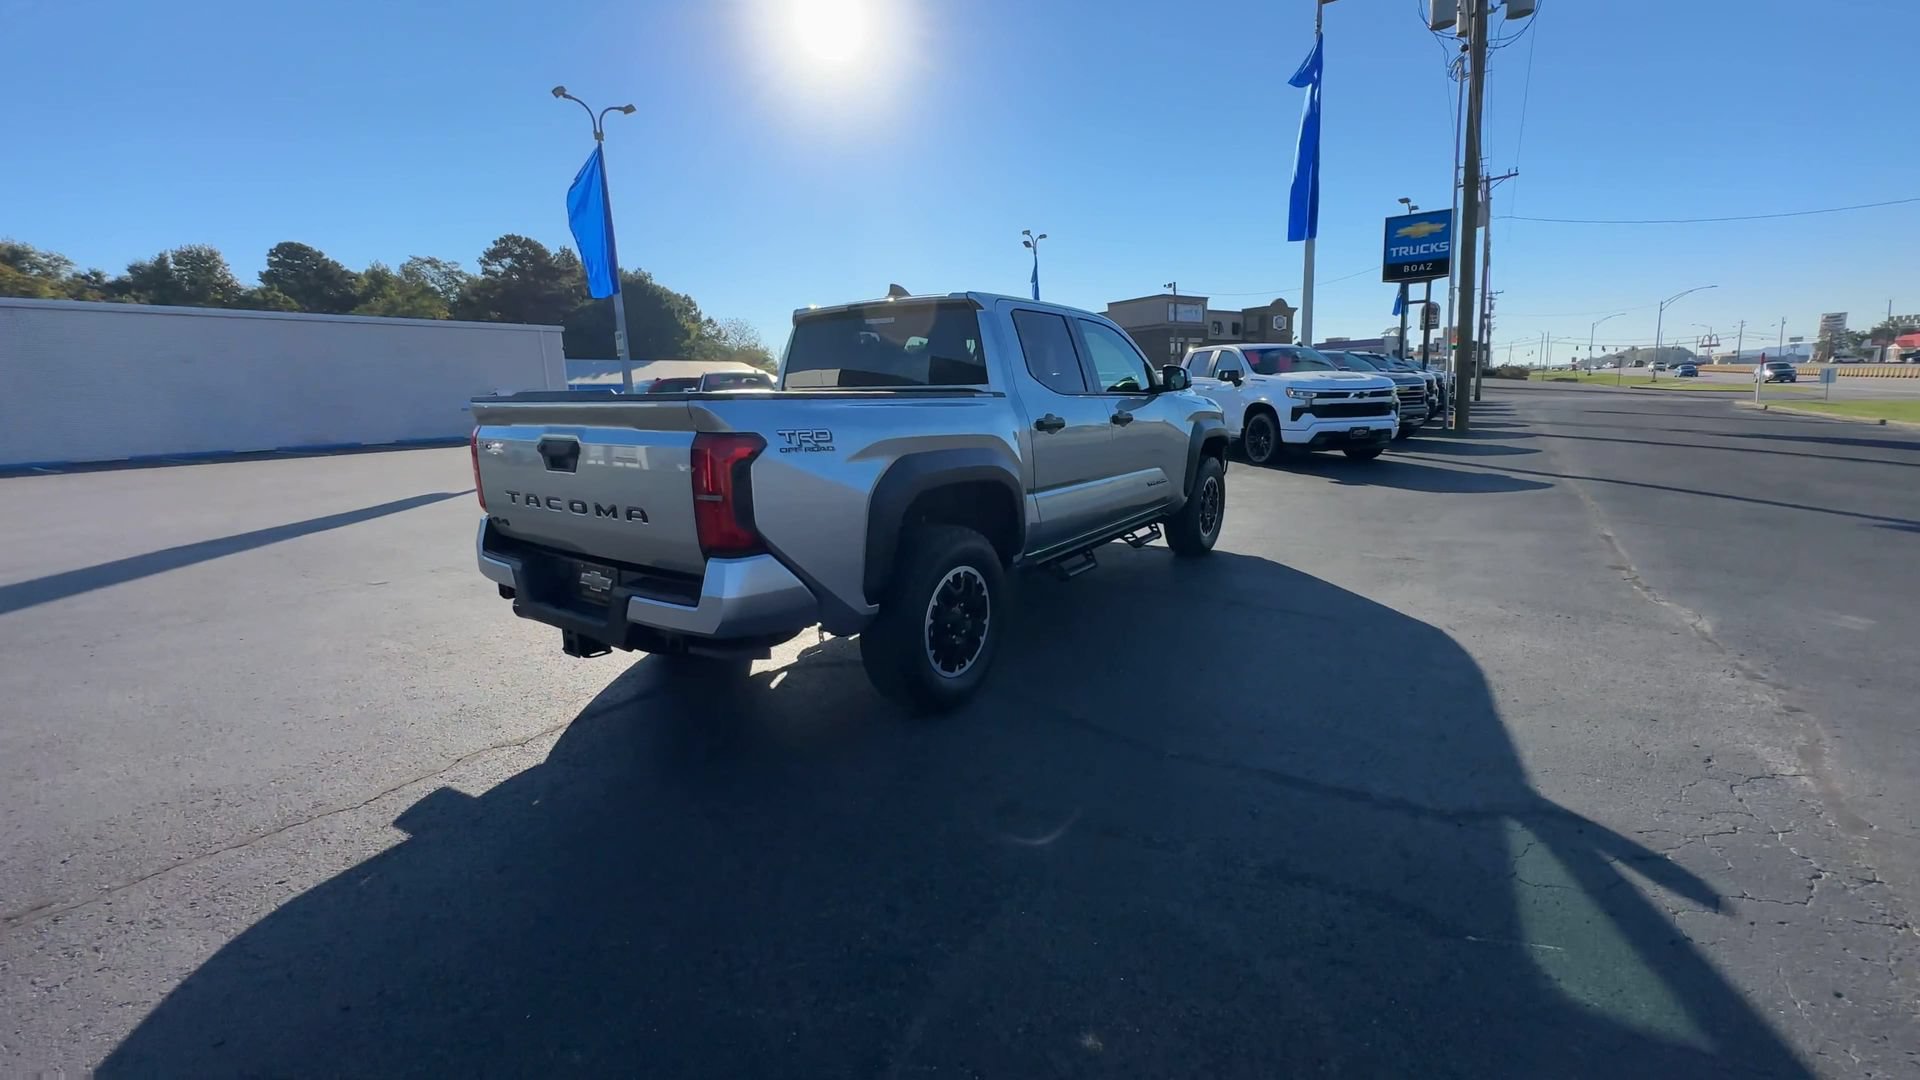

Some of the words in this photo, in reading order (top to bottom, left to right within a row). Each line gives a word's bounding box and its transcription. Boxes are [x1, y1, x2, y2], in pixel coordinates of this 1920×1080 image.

[1390, 241, 1449, 257] TRUCKS
[1403, 262, 1433, 273] BOAZ
[776, 428, 833, 447] TRD
[505, 490, 649, 524] TACOMA
